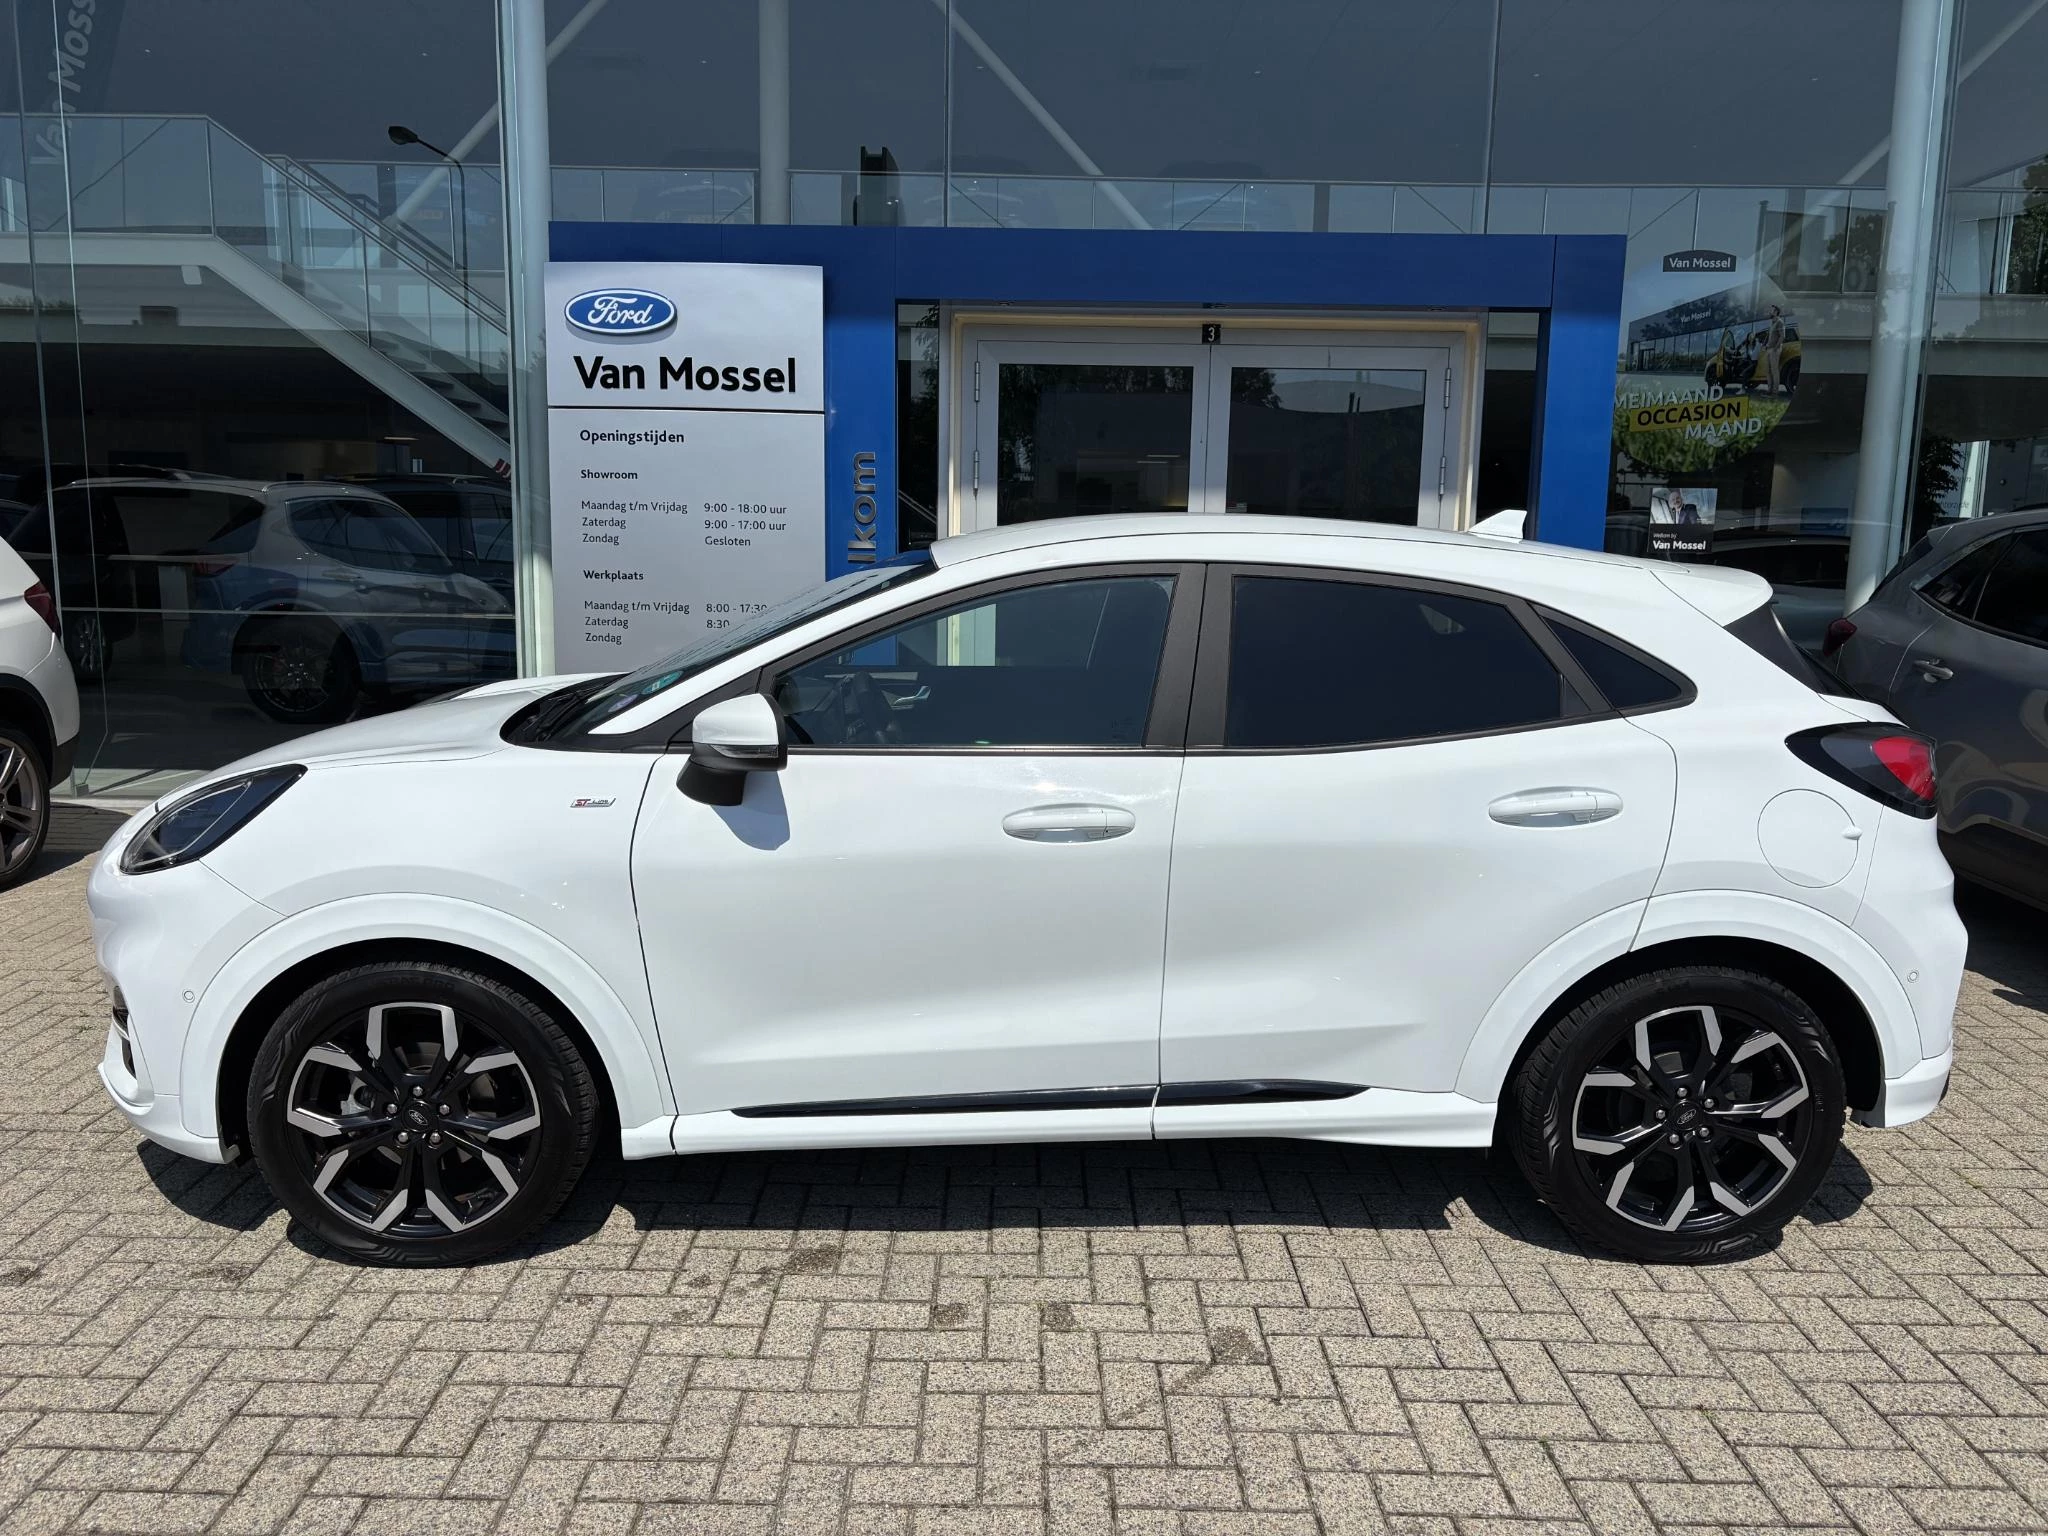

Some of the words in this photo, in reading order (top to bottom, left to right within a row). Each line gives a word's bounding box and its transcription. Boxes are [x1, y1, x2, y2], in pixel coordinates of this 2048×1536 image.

[1669, 257, 1690, 268] Van
[1692, 257, 1731, 268] Mossel
[587, 296, 653, 324] Ford
[1207, 326, 1215, 342] 3
[572, 355, 646, 390] Van
[659, 356, 796, 393] Mossel
[1637, 401, 1741, 426] OCCASION
[1684, 418, 1762, 440] MAAND
[579, 429, 685, 446] Openingstijden
[580, 468, 638, 480] Showroom
[581, 500, 627, 514] Maandag
[628, 501, 648, 511] t/m
[650, 501, 688, 515] Vrijdag
[703, 502, 728, 513] 9:00
[737, 503, 767, 514] 18:00
[769, 506, 788, 515] uur
[582, 516, 627, 530] Zaterdag
[704, 519, 728, 530] 9:00
[737, 520, 767, 530] 17:00
[768, 523, 787, 531] uur
[582, 533, 620, 546] Zondag
[704, 535, 751, 547] Gesloten
[1653, 540, 1670, 549] Van
[1673, 540, 1706, 550] Mossel
[583, 569, 644, 583] Werkplaats
[584, 600, 630, 614] Maandag
[631, 601, 651, 611] t/m
[652, 601, 690, 615] Vrijdag
[706, 603, 730, 613] 8:00
[584, 616, 629, 630] Zaterdag
[706, 619, 730, 629] 8:30
[585, 632, 622, 646] Zondag
